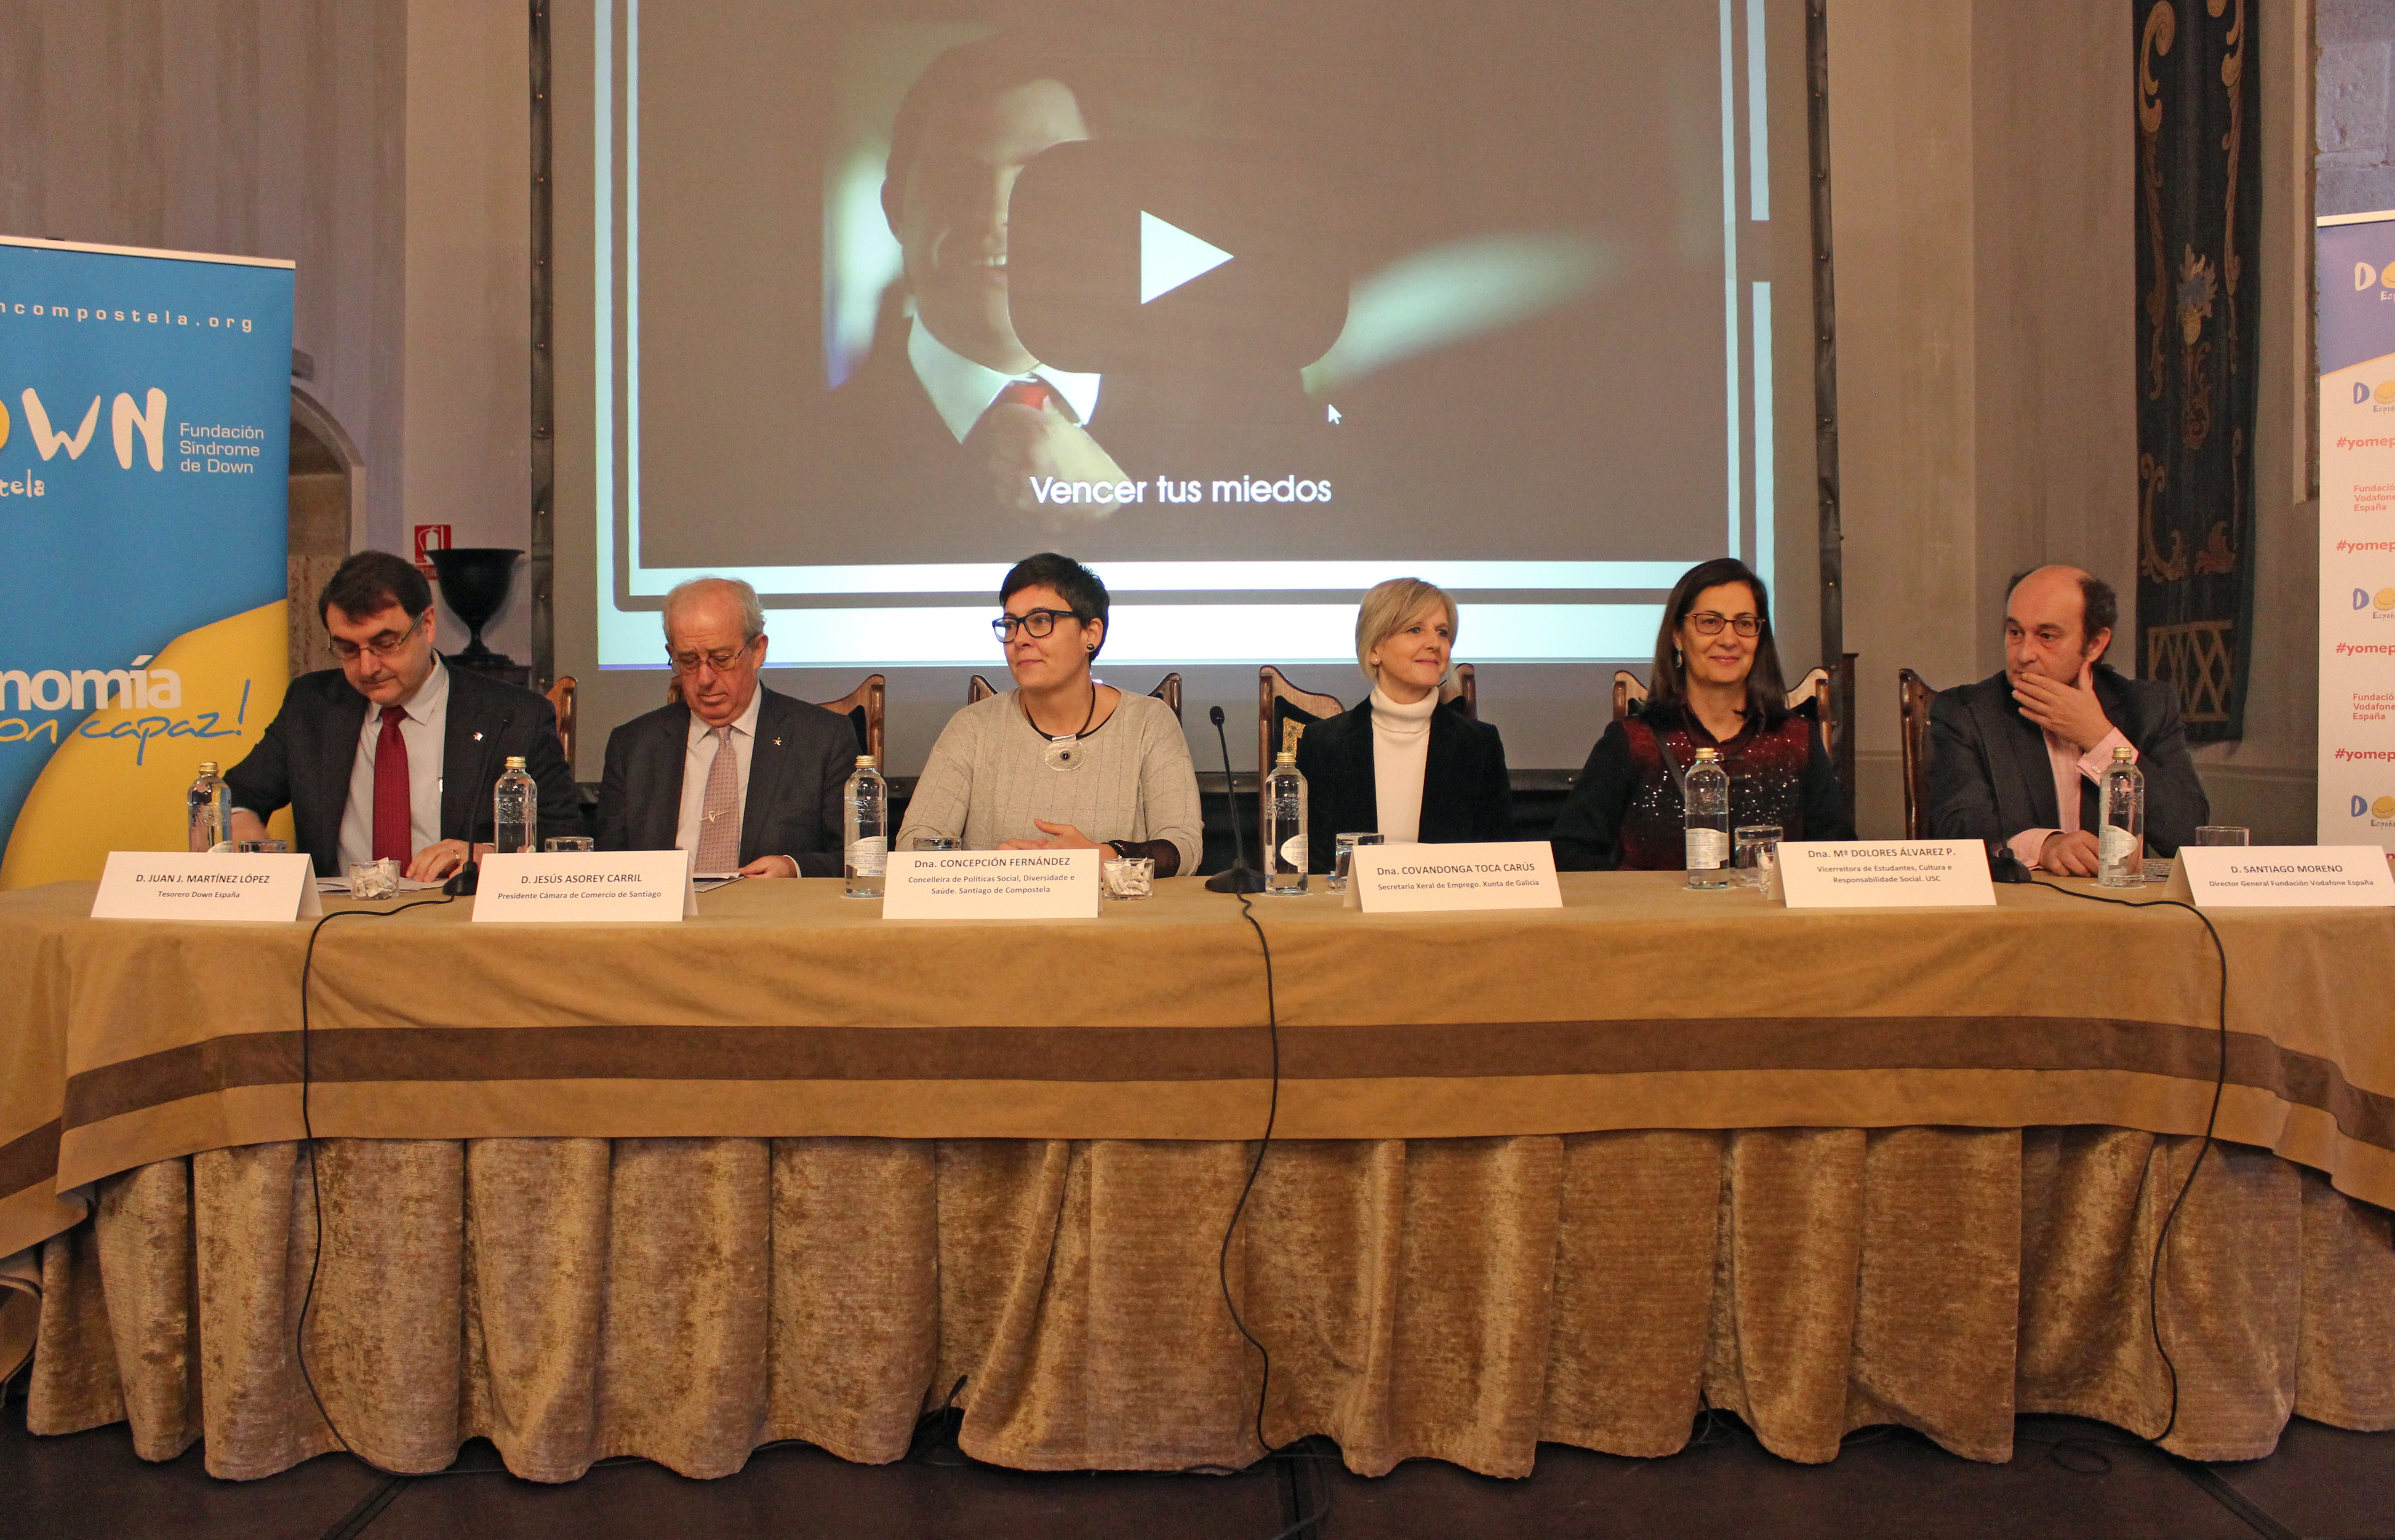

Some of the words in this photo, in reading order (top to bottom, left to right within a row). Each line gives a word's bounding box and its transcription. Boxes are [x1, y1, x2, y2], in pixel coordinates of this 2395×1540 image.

[0, 387, 167, 472] WN
[180, 423, 264, 439] Fundación
[180, 441, 260, 456] Síndrome
[181, 459, 201, 472] de
[208, 460, 253, 474] Down
[1030, 476, 1148, 504] Vencer
[1156, 475, 1202, 503] tus
[1212, 474, 1332, 503] miedos
[2354, 503, 2387, 512] España
[2353, 713, 2385, 721] España
[1900, 847, 1944, 856] ÁLVAREZ
[941, 857, 1006, 867] CONCEPCIÓN
[1010, 857, 1070, 866] FERNÁNDEZ
[1402, 866, 1473, 874] COVANDONGA
[1503, 862, 1534, 871] CARÚS
[187, 874, 237, 882] MARTÍNEZ
[240, 874, 269, 883] LÓPEZ
[534, 874, 562, 883] JESÚS
